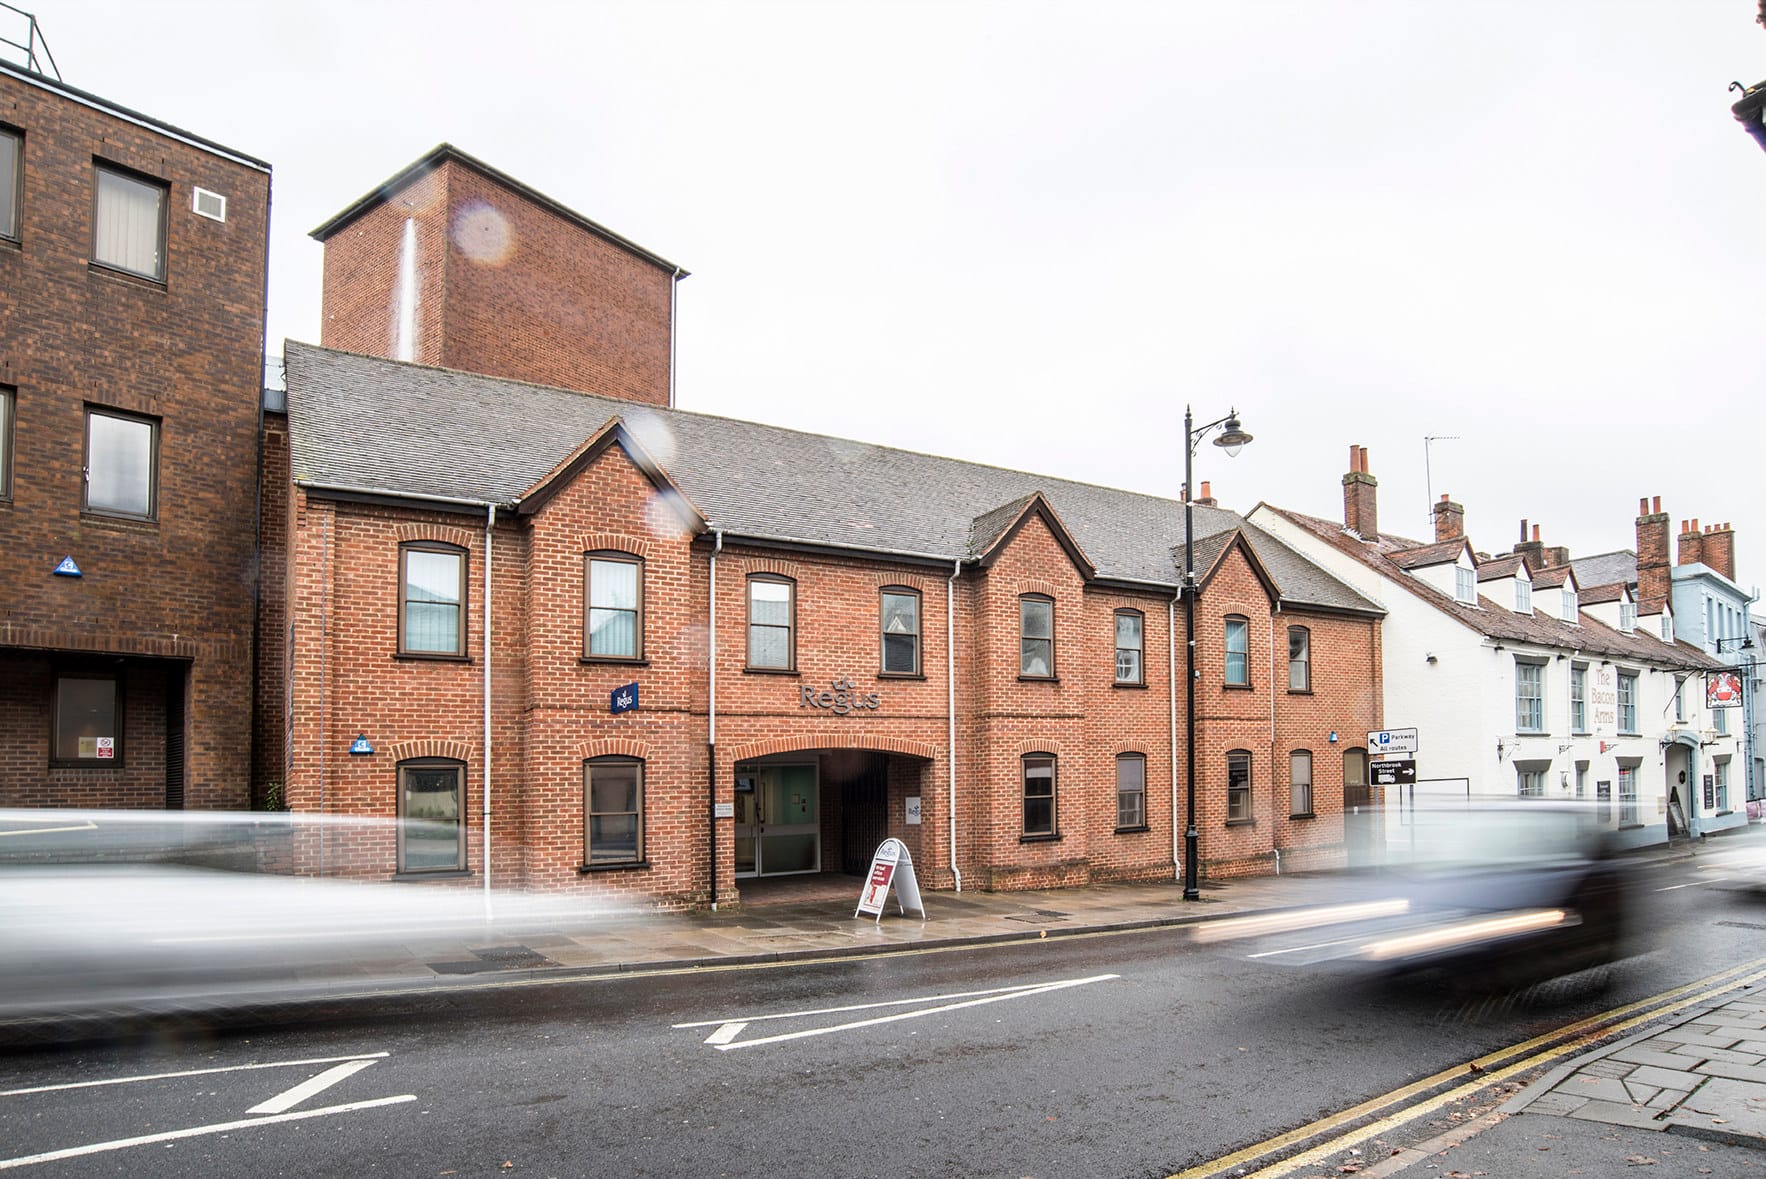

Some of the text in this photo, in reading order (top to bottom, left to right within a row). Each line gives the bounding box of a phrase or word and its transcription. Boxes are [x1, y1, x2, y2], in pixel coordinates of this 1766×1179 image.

[1596, 669, 1610, 686] The
[799, 684, 880, 714] Regus
[1591, 688, 1615, 704] Bacon
[1594, 707, 1614, 724] Arms
